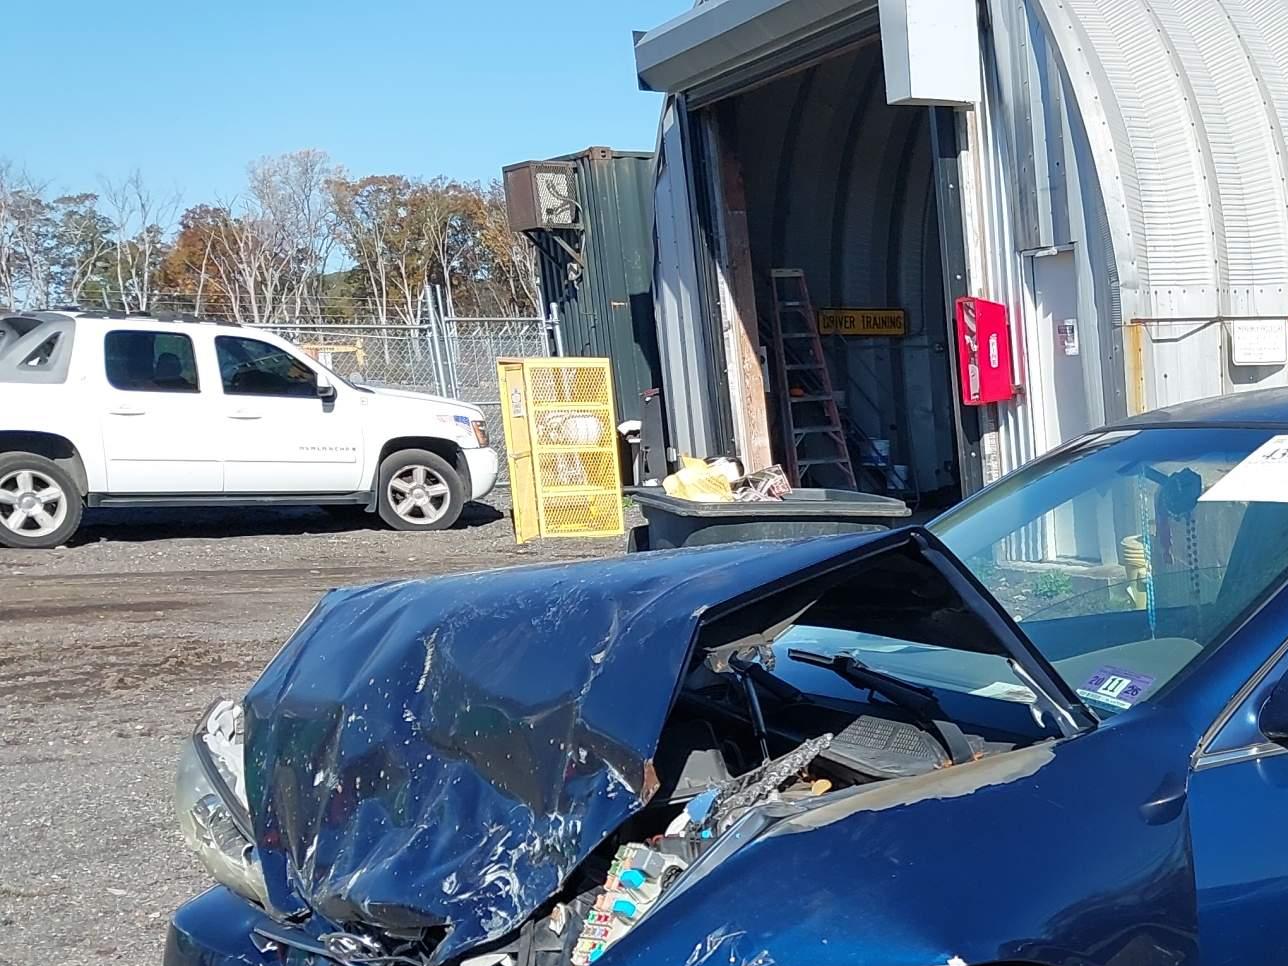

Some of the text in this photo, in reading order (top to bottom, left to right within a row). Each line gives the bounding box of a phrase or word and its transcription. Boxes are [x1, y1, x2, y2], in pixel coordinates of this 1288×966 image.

[823, 315, 902, 329] DRIVER TRAINING
[1088, 675, 1142, 697] 20 11 26
